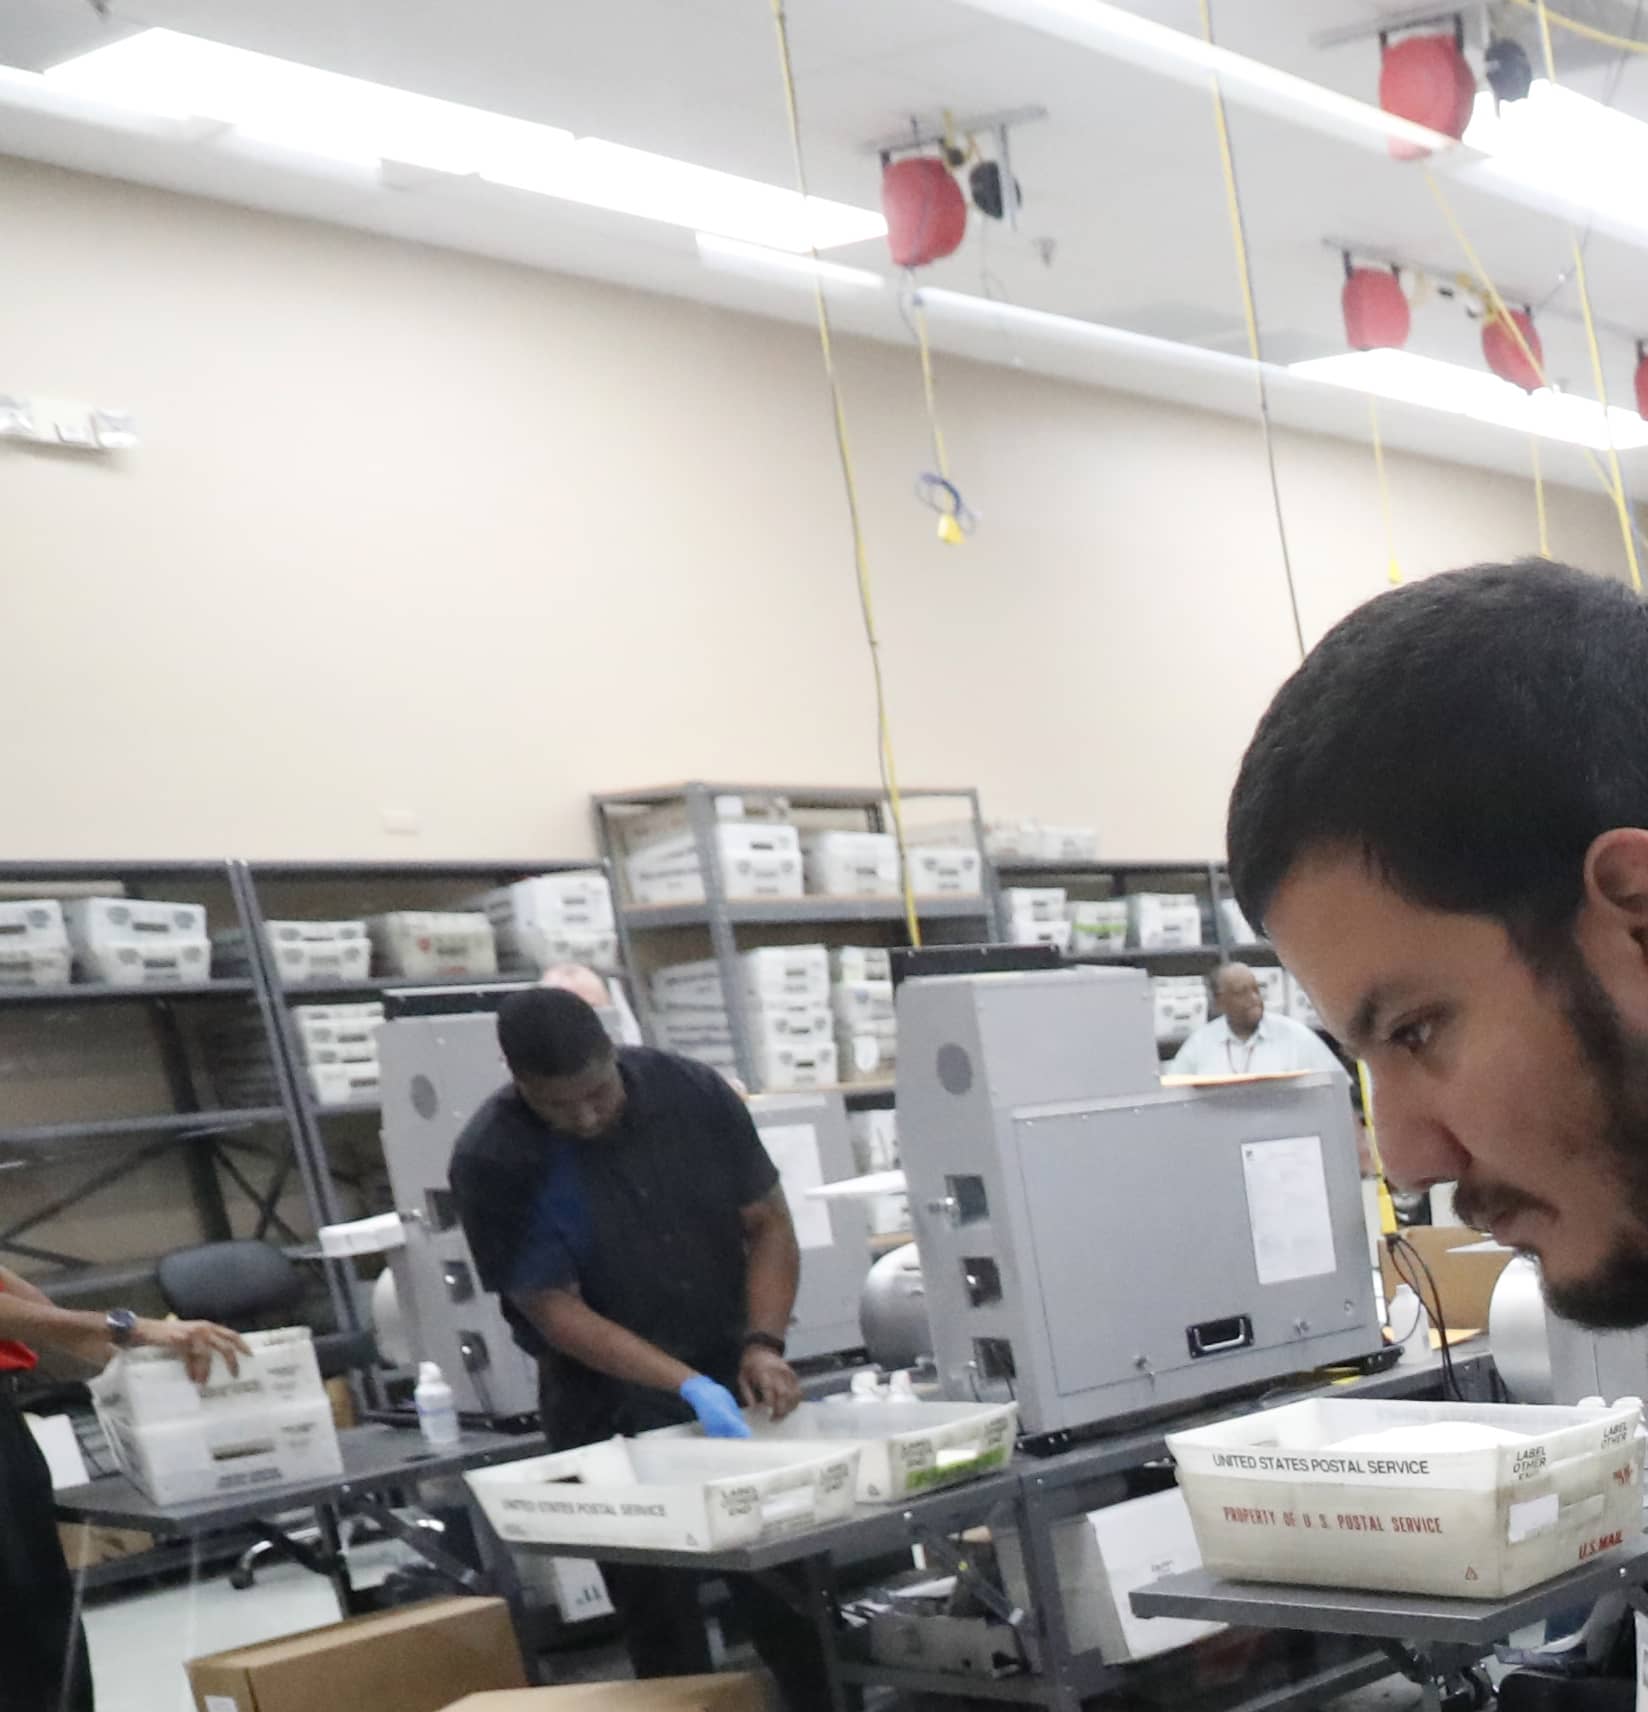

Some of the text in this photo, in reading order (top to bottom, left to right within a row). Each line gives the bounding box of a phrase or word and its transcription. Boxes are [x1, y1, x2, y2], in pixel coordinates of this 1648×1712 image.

[1603, 1422, 1628, 1438] LABEL
[1516, 1446, 1547, 1461] LABEL
[1213, 1453, 1431, 1475] UNITED STATES POSTAL SERVICE
[1513, 1457, 1547, 1473] OTHER
[576, 1502, 617, 1516] POSTAL
[620, 1503, 666, 1517] SERVICE
[1223, 1506, 1277, 1525] PROPERTY
[1283, 1511, 1297, 1527] OF
[1337, 1514, 1384, 1532] POSTAL
[1391, 1517, 1443, 1534] SERVICE
